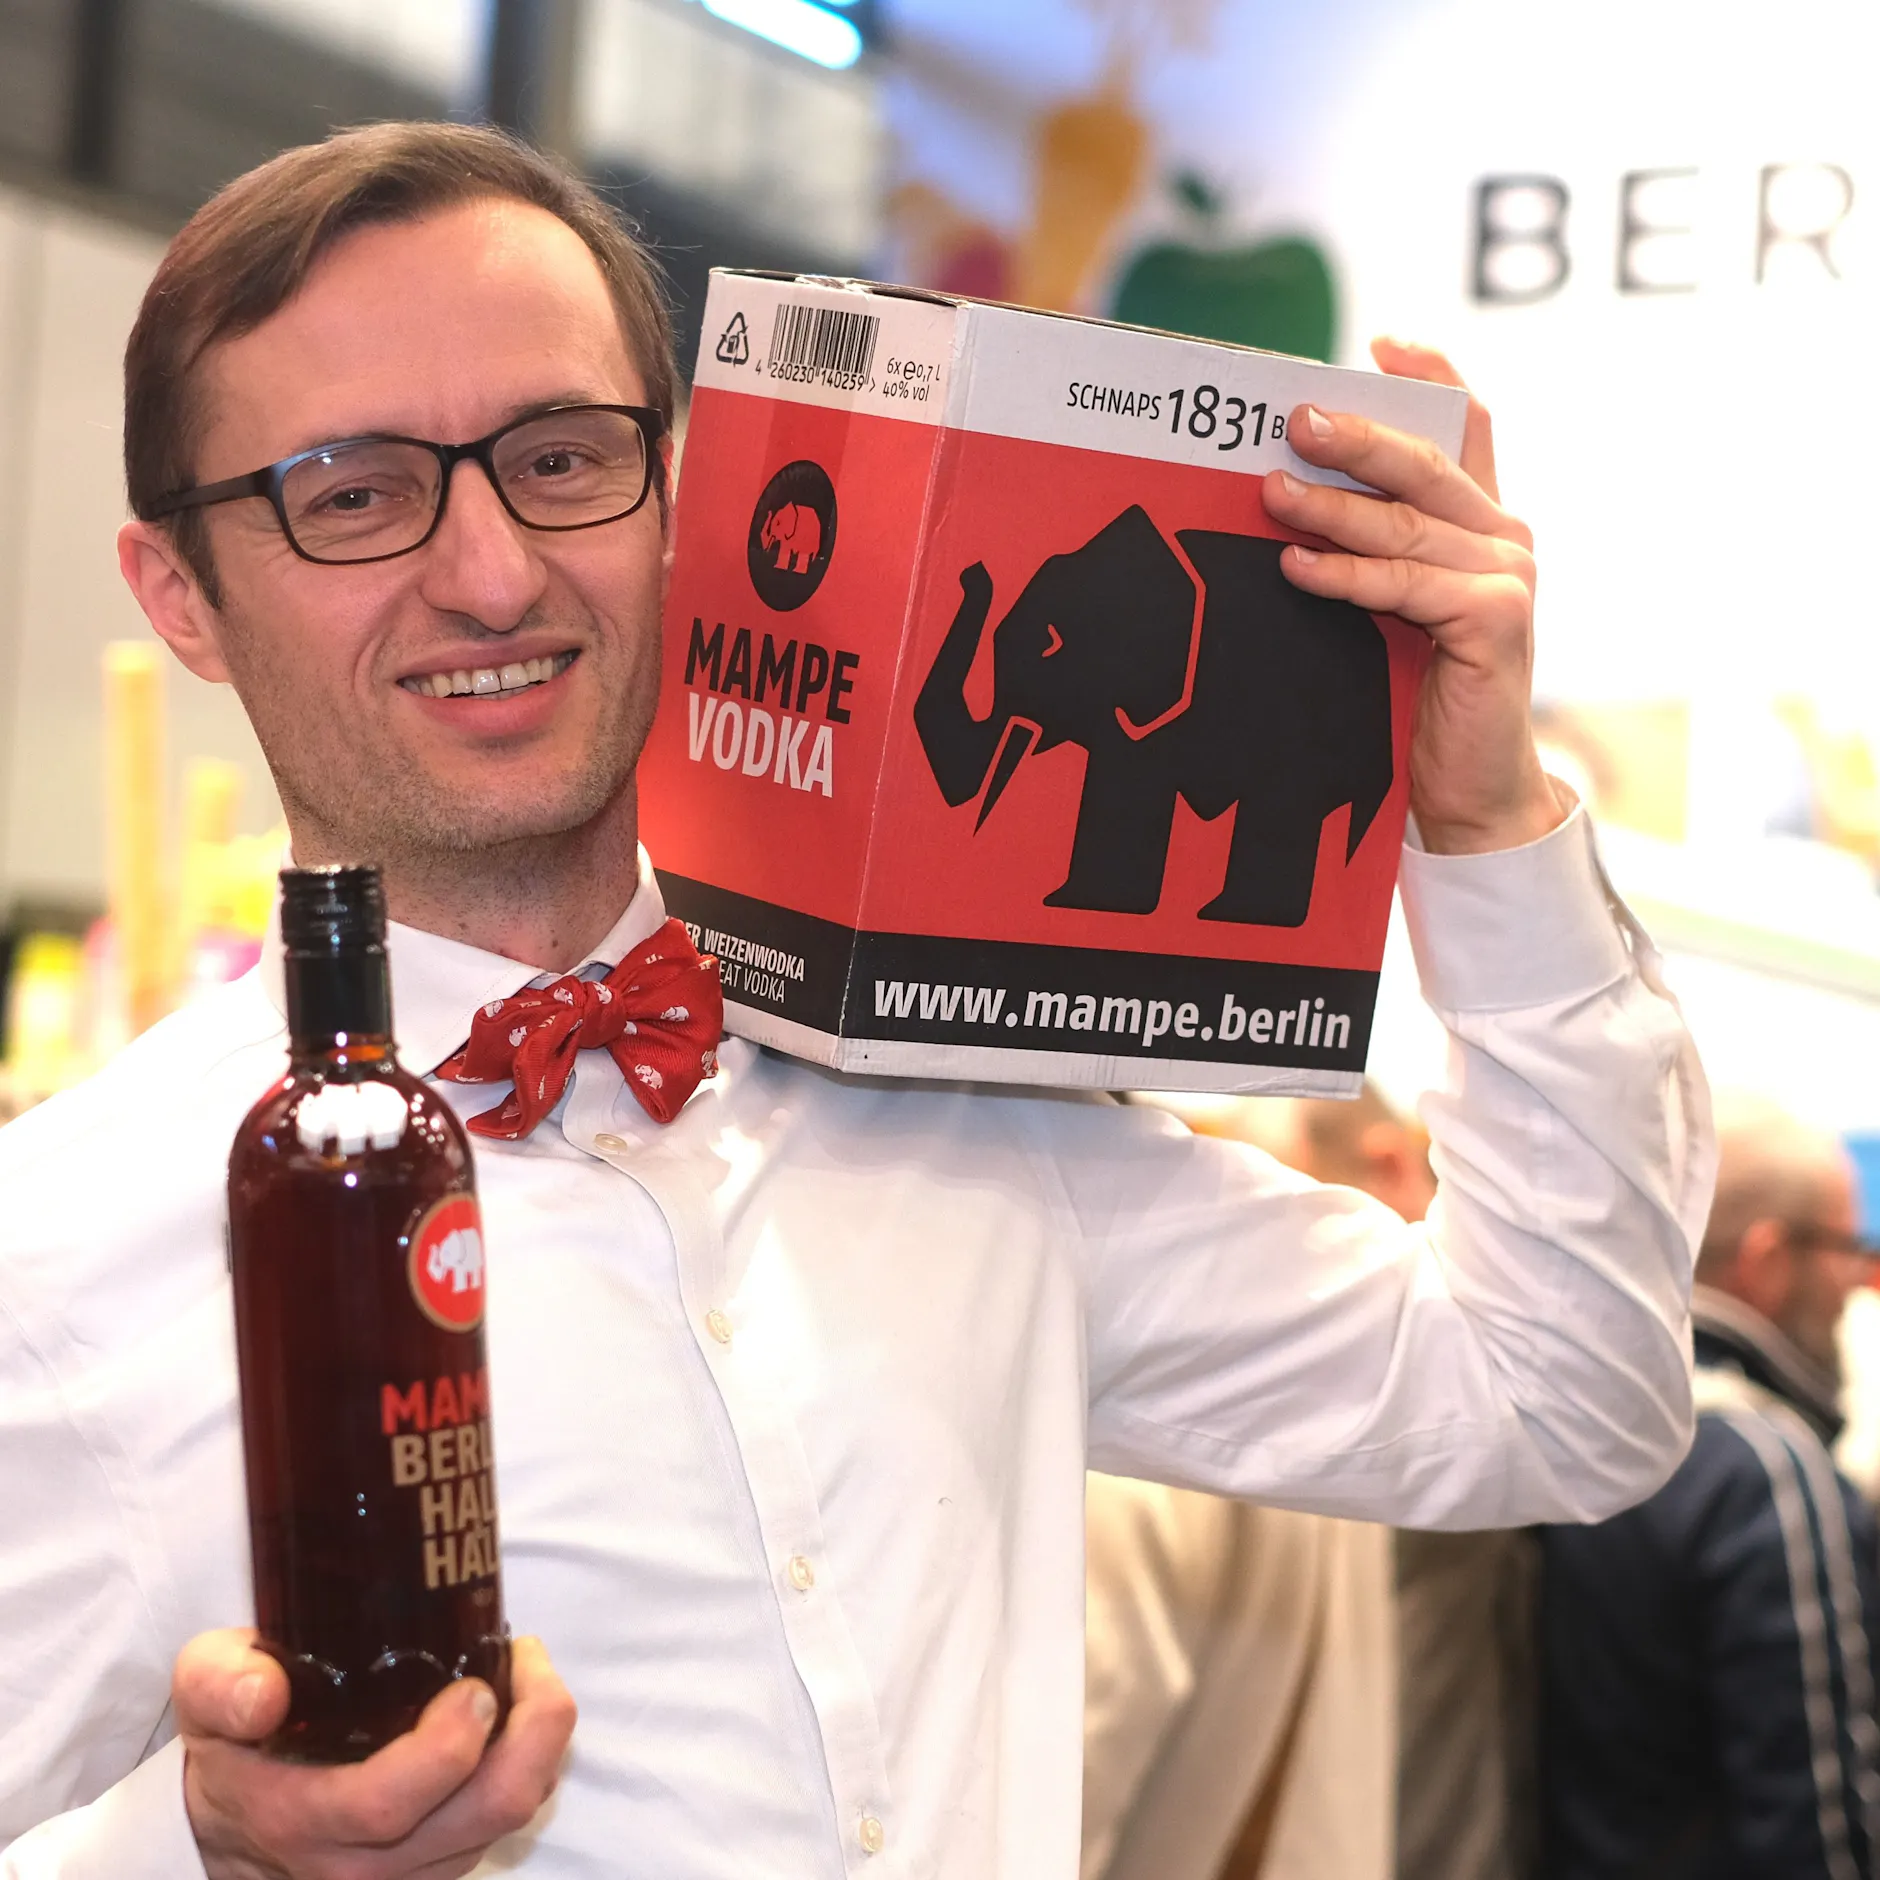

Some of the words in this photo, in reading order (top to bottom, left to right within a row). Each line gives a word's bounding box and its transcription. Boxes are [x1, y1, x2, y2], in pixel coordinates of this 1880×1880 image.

[770, 361, 816, 384] 260230
[821, 368, 865, 392] 140259
[882, 380, 909, 399] 40%
[913, 384, 930, 402] vol
[1066, 382, 1162, 420] SCHNAPS
[1168, 384, 1268, 451] 1831
[1271, 415, 1289, 440] B
[684, 616, 860, 724] MAMPE
[688, 691, 834, 798] VODKA
[704, 927, 806, 982] WEIZENWODKA
[743, 968, 786, 1004] VODKA
[873, 979, 1351, 1048] www.mampe.berlin
